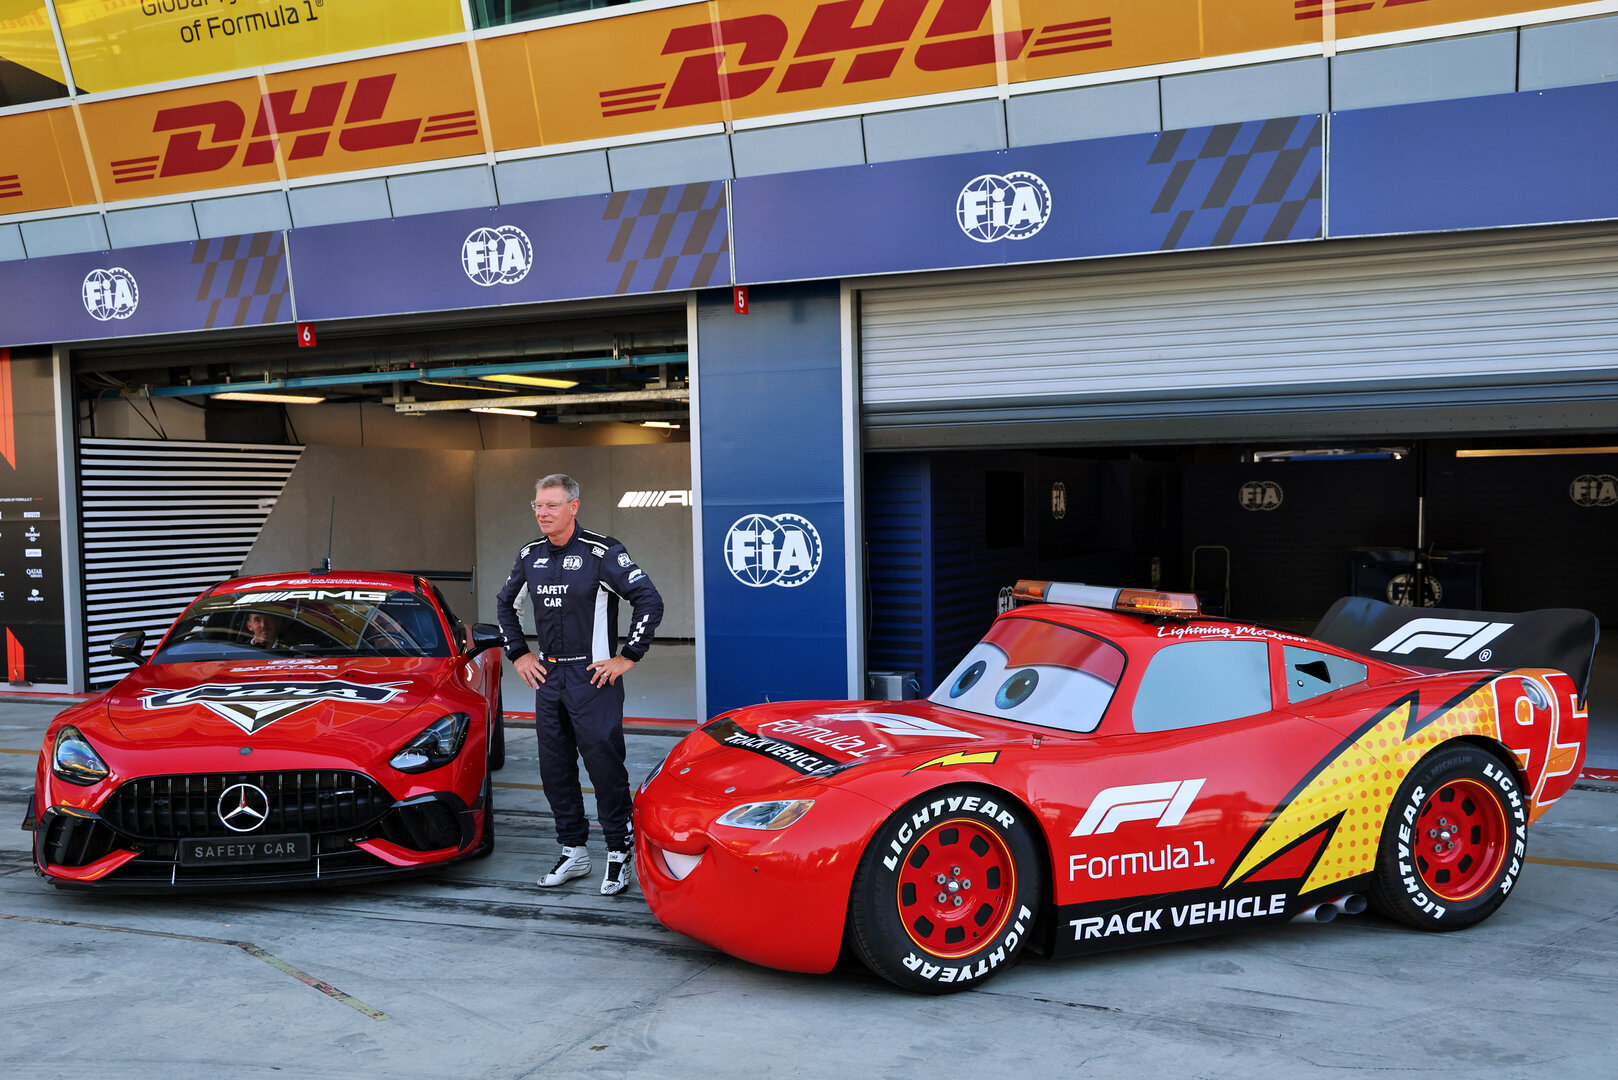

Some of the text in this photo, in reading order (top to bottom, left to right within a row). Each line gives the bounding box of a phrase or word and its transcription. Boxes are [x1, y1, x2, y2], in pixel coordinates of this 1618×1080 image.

[180, 20, 201, 43] of
[207, 5, 300, 39] Formula
[659, 0, 1035, 109] DHL
[152, 73, 423, 178] DHL
[738, 291, 745, 308] 5
[303, 326, 311, 341] 6
[281, 590, 387, 602] AMG
[536, 585, 569, 595] SAFETY
[544, 598, 562, 607] CAR
[1157, 626, 1230, 639] Lightning
[166, 686, 368, 703] Cars
[724, 732, 834, 774] TRACK VEHICLE
[758, 719, 866, 751] Formula
[1490, 672, 1588, 807] 95
[882, 795, 1015, 873] LIGHTYEAR
[1482, 763, 1527, 895] LIGHTYEAR
[195, 843, 295, 858] SAFETY CAR
[1069, 844, 1189, 881] Formula
[1397, 785, 1446, 920] LIGHTYEAR
[1069, 893, 1287, 941] TRACK VEHICLE
[902, 905, 1031, 985] LIGHTYEAR
